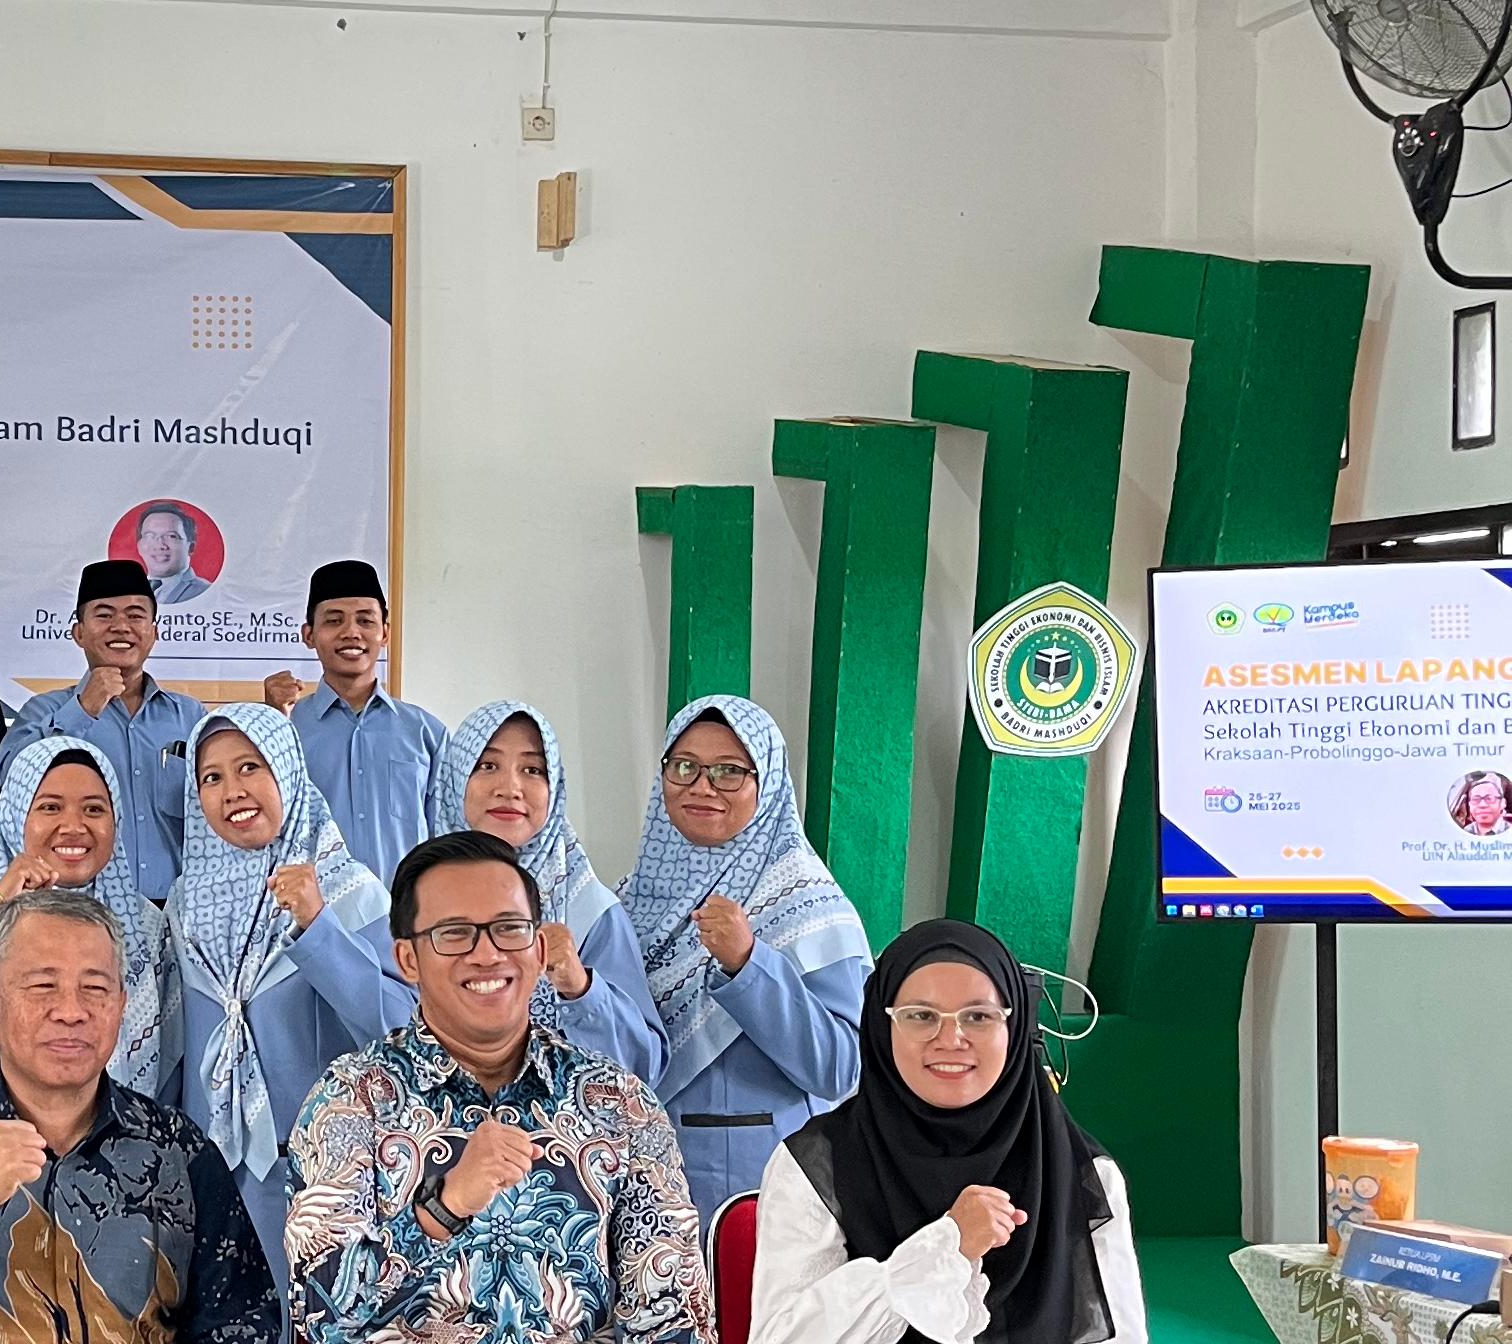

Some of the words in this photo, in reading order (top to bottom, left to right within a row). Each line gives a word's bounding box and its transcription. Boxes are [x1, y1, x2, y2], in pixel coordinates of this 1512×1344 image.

[56, 415, 140, 443] Badri
[154, 417, 313, 454] Mashduqi
[35, 609, 62, 624] Dr.
[1303, 601, 1355, 616] Kampus
[1303, 610, 1360, 624] Merdeka
[250, 612, 299, 627] M.Sc.
[1030, 611, 1076, 626] EKONOMI
[1077, 617, 1096, 636] DAN
[22, 625, 73, 640] Unive
[213, 627, 300, 643] Soedirma
[1000, 622, 1029, 650] TINGGI
[1094, 632, 1111, 663] BISNIS
[991, 650, 1005, 693] SEKOLAH
[1099, 666, 1113, 696] ISLAM
[1203, 660, 1368, 688] ASESMEN
[1375, 657, 1512, 685] LAPANG
[1203, 697, 1319, 716] AKREDITASI
[1326, 694, 1455, 713] PERGURUAN
[1461, 692, 1512, 710] TING
[1001, 711, 1031, 736] BADRI
[1033, 713, 1092, 739] MASHDUQI
[1203, 722, 1282, 740] Sekolah
[1288, 721, 1352, 743] Tinggi
[1359, 720, 1450, 738] Ekonomi
[1457, 718, 1496, 736] dan
[1204, 743, 1447, 762] Kraksaan-Probolinggo-Jawa
[1452, 743, 1505, 758] Timur
[1248, 802, 1269, 811] MEI
[1271, 802, 1301, 811] 2025
[1401, 841, 1430, 851] Prof.
[1433, 841, 1451, 852] Dr.
[1447, 851, 1500, 862] Alauddin
